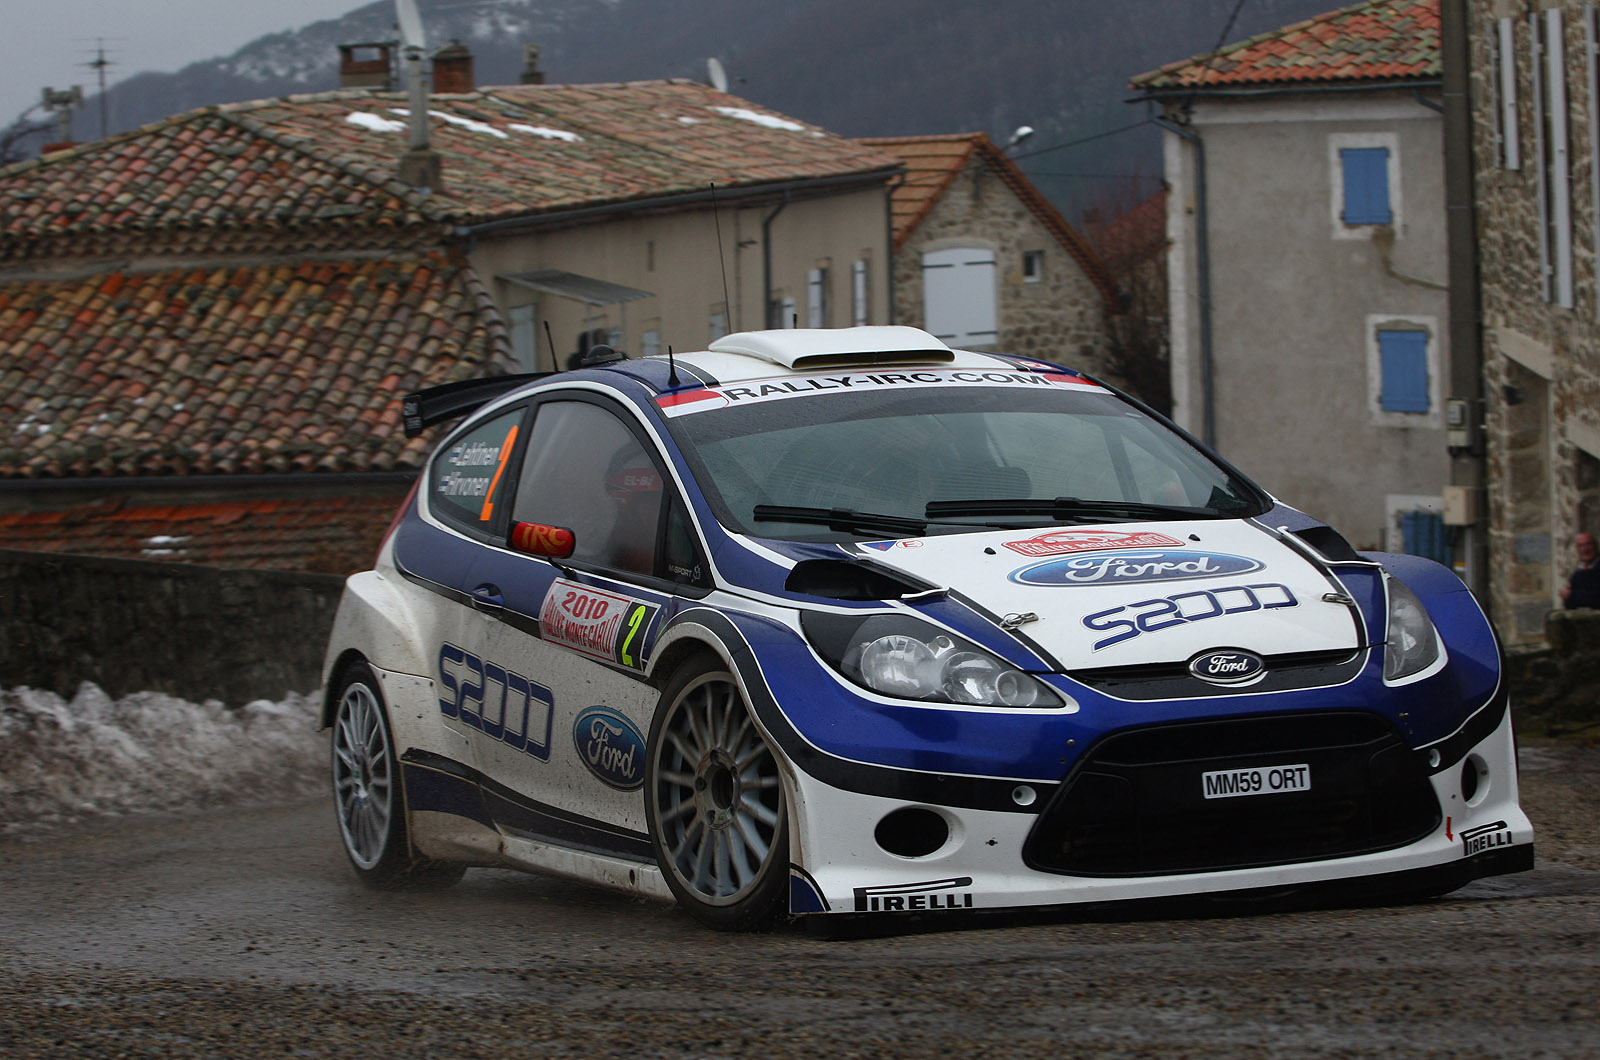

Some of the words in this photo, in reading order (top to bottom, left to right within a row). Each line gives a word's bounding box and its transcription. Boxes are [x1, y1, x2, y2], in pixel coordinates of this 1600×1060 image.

[726, 371, 1052, 401] RALLY-IRC.COM
[480, 425, 519, 521] 2
[1065, 554, 1220, 582] Ford
[561, 591, 609, 620] 2010
[1082, 583, 1300, 652] S2000
[622, 605, 646, 667] 2
[1208, 655, 1248, 674] Ford
[439, 641, 554, 764] S2000
[588, 718, 636, 779] Ford
[1205, 771, 1262, 796] MM59
[1268, 767, 1307, 790] ORT
[1459, 820, 1512, 856] PIRELLI
[853, 876, 973, 912] PIRELLI
